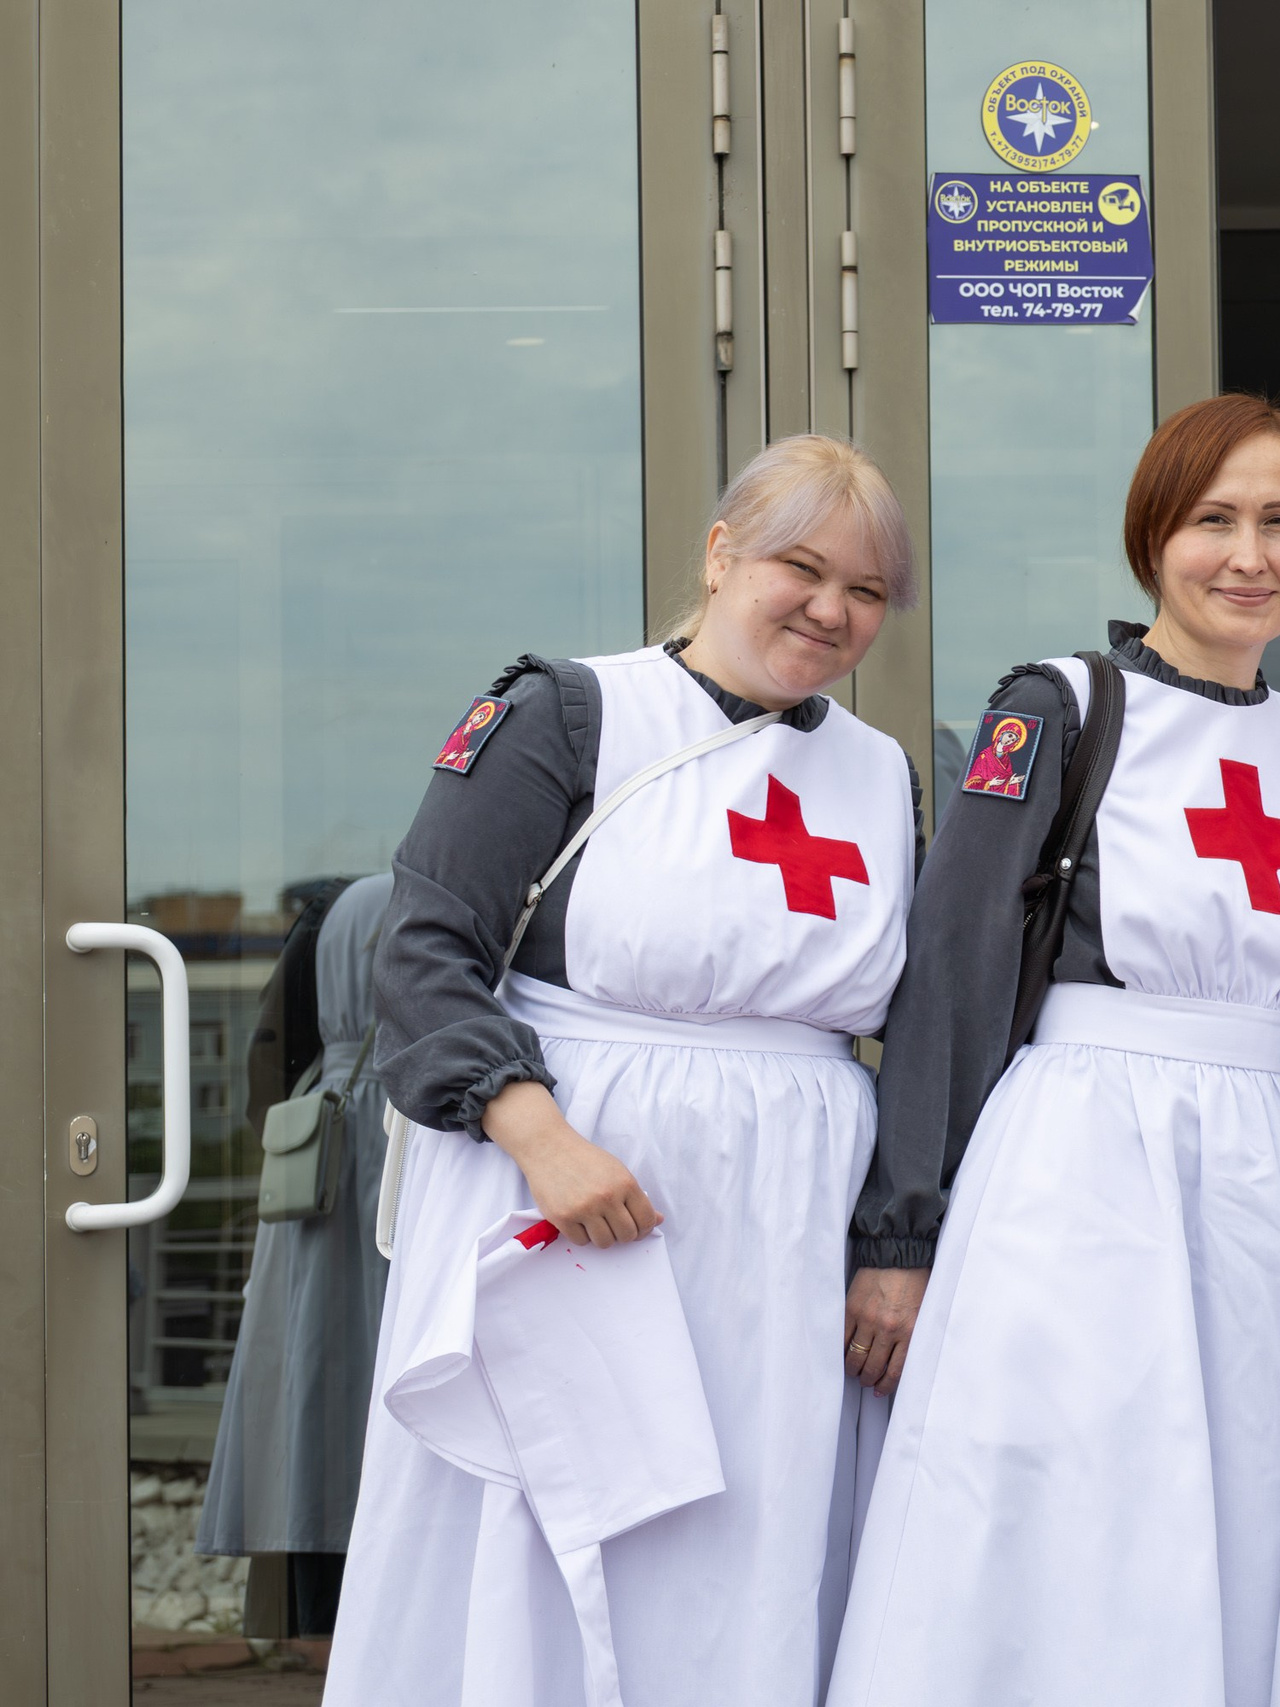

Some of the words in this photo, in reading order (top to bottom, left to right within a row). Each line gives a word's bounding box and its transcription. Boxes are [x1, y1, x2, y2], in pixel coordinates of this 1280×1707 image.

[988, 71, 1017, 112] ОБЪЕКТ
[1021, 66, 1046, 76] ПОД
[1050, 70, 1088, 117] ОХРАНОЙ
[1006, 94, 1071, 125] Восток
[990, 181, 1013, 193] НА
[1017, 181, 1089, 194] ОБЪЕКТЕ
[986, 201, 1093, 213] УСТАНОВЛЕН
[977, 219, 1088, 233] ПРОПУСКНОЙ
[1093, 221, 1104, 233] И
[954, 239, 1128, 253] ВНУТРИОБЪЕКТОВЫЙ
[1004, 260, 1079, 272] РЕЖИМЫ
[959, 283, 1004, 297] ООО
[1009, 283, 1051, 297] ЧОП
[1057, 284, 1124, 298] Восток
[981, 304, 1018, 317] тел.
[1023, 303, 1103, 318] 74-79-77
